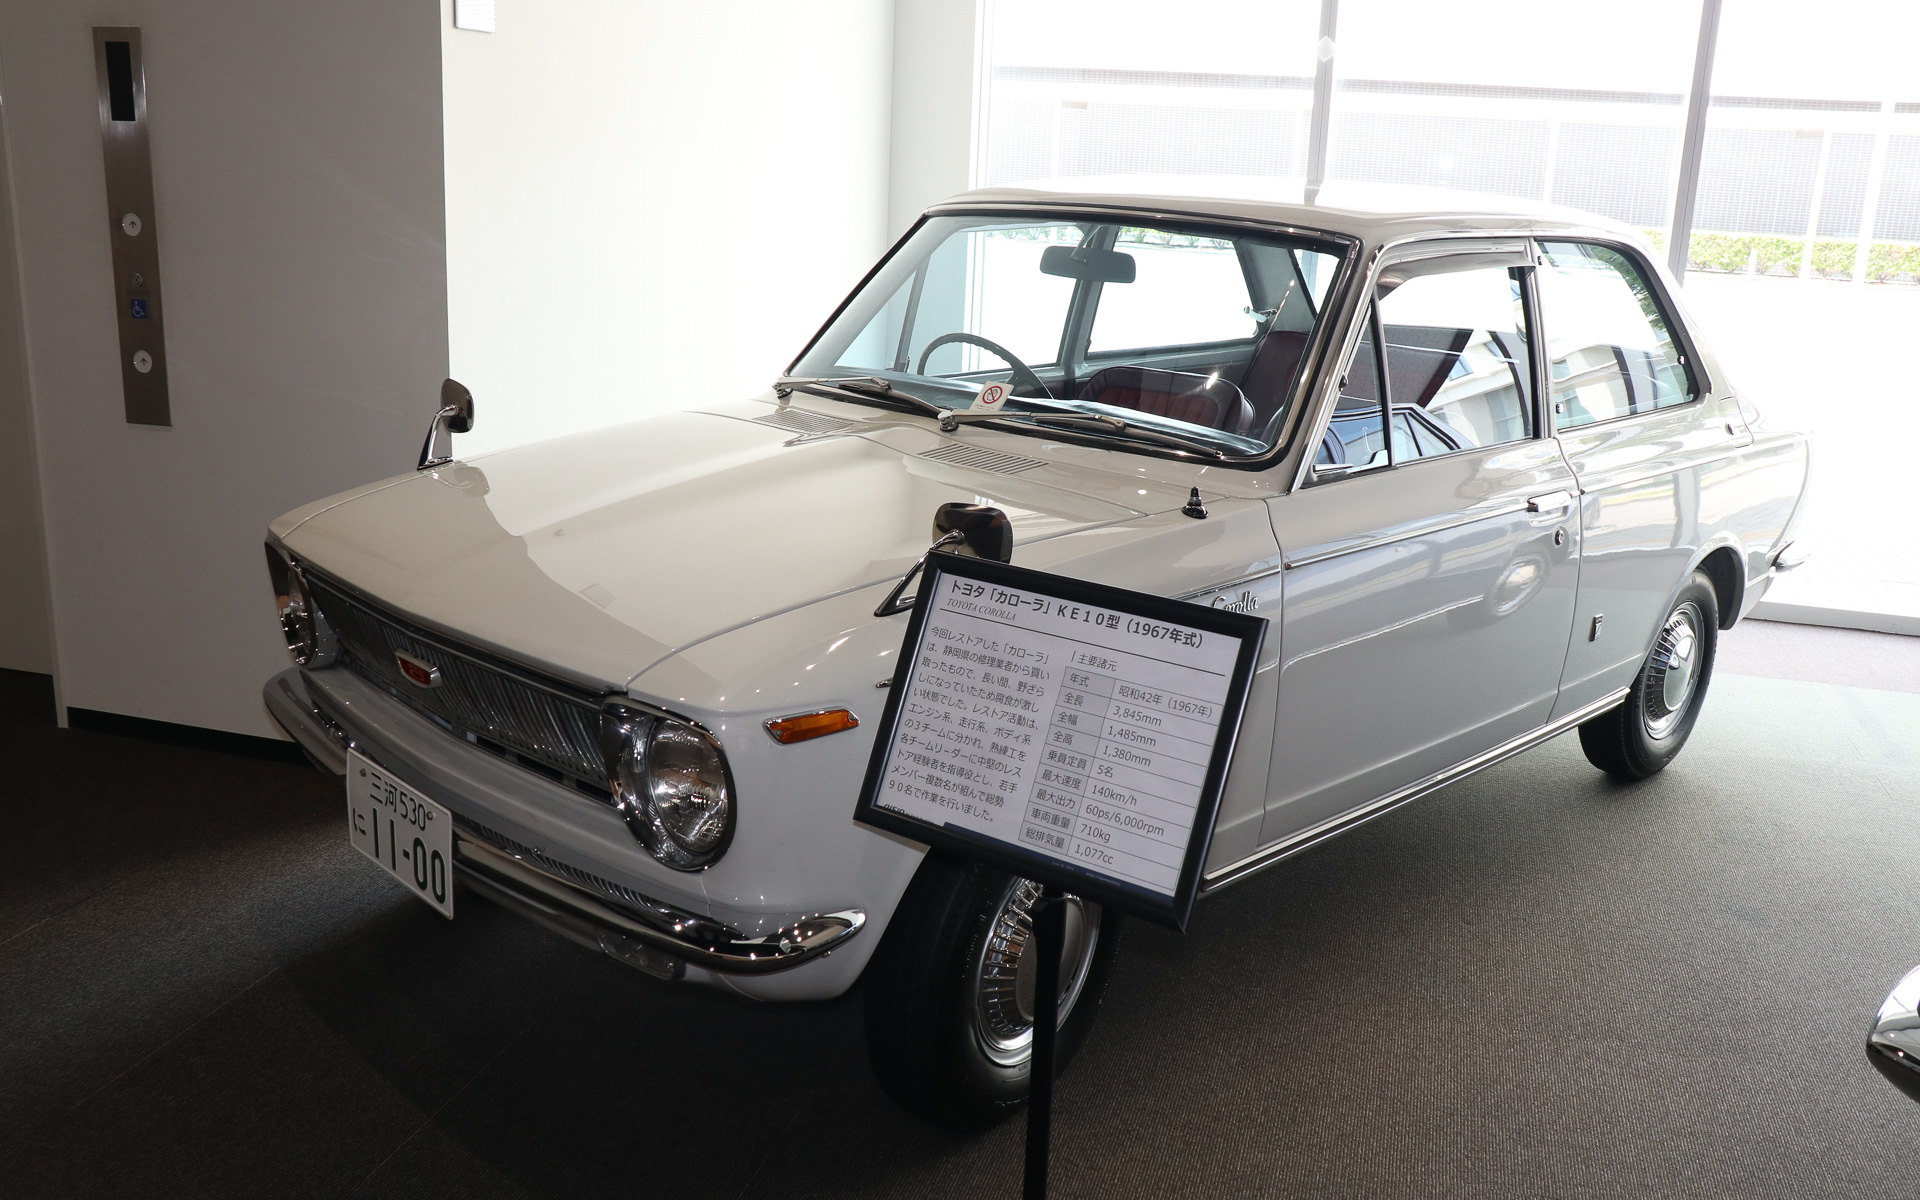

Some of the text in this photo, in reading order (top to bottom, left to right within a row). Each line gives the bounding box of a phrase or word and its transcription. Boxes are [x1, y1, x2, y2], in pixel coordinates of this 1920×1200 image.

[947, 598, 1017, 621] TOYOTA COROLLA
[1211, 591, 1259, 613] Corolla
[1070, 673, 1089, 687] 年式
[1064, 693, 1083, 706] 全長
[1058, 712, 1078, 725] 全幅
[1113, 706, 1161, 726] 3,845mm
[1053, 731, 1073, 745] 全高
[1108, 726, 1156, 746] 1,485mm
[1047, 750, 1086, 770] 乗員定員
[1103, 746, 1150, 766] 1,380mm
[1042, 770, 1082, 790] 最大速度
[1097, 765, 1112, 778] 5名
[1037, 789, 1075, 809] 最大出力
[1092, 785, 1137, 806] 140km/h
[1031, 808, 1070, 829] 車両重量
[1085, 805, 1165, 836] 60ps/6,000rpm
[1026, 828, 1064, 849] 総排気量
[1081, 824, 1110, 843] 710kg
[353, 807, 446, 904] に 11-00
[1075, 844, 1114, 864] 1,077cc
